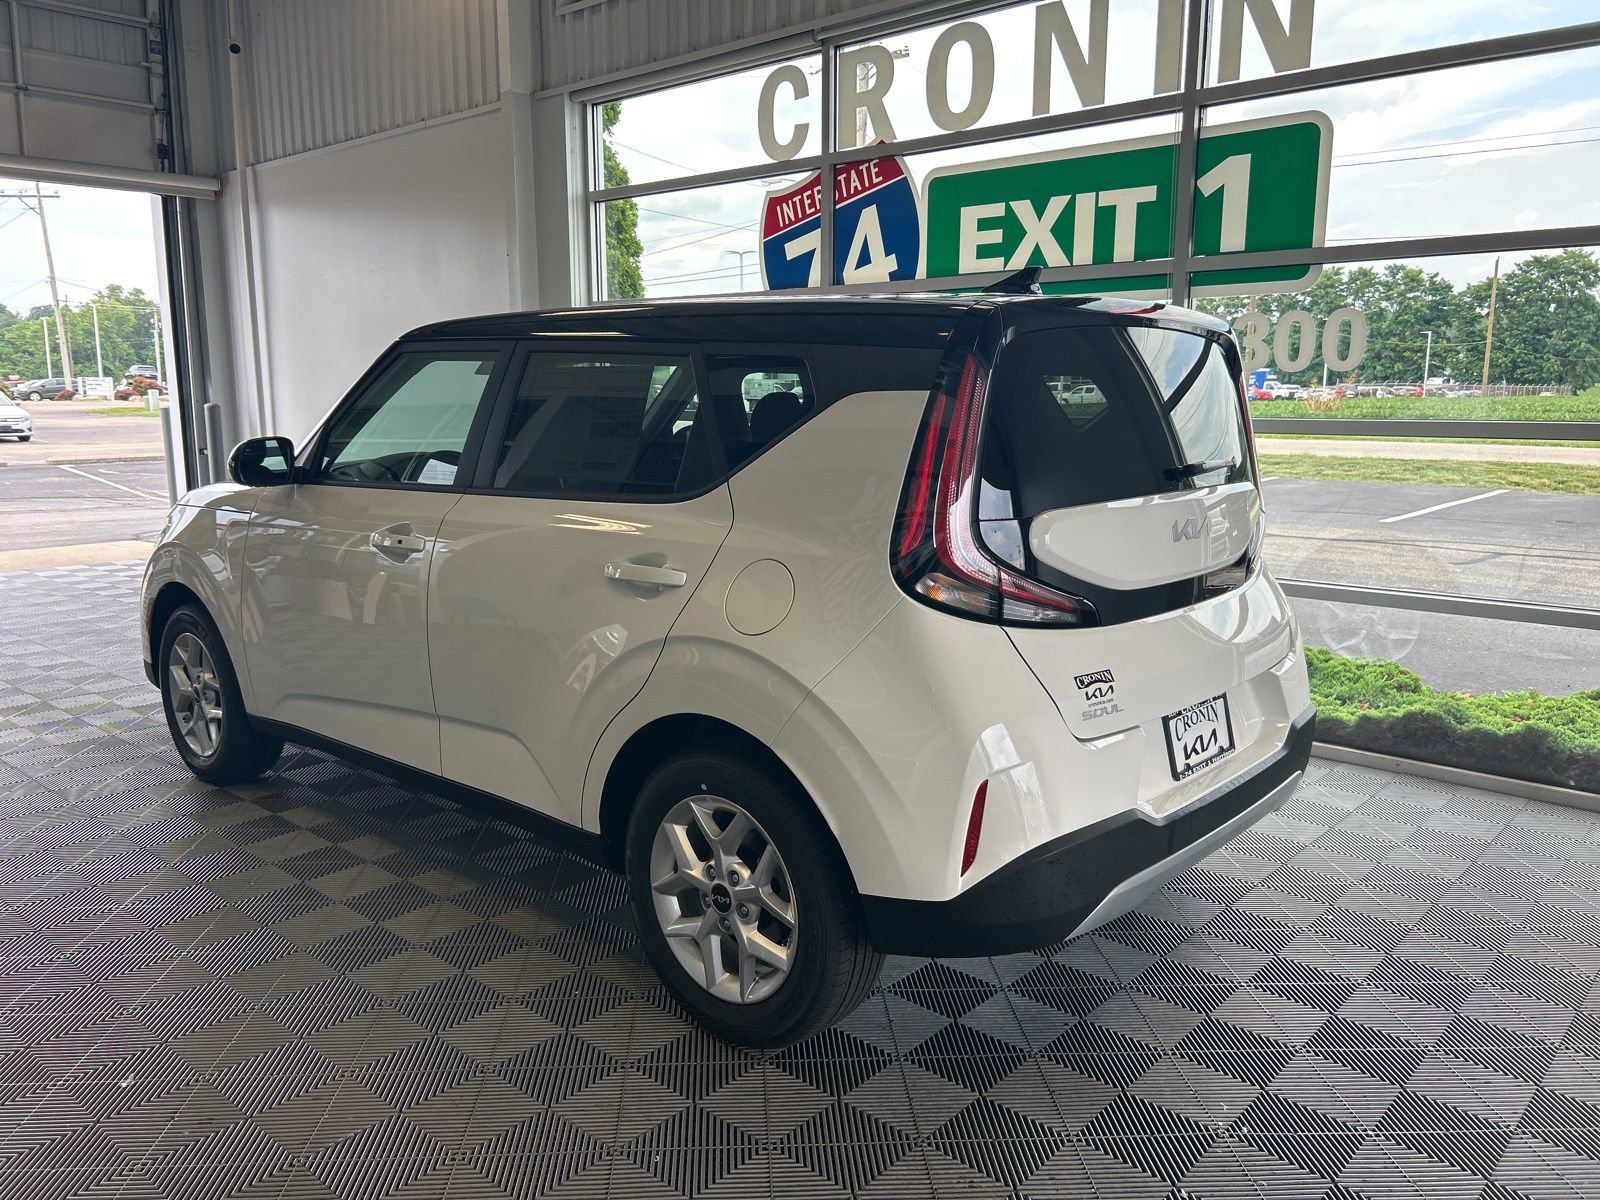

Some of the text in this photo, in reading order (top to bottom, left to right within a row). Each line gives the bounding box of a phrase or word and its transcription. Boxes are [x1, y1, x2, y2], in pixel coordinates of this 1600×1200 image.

[758, 0, 1315, 162] CRONIN
[958, 153, 1252, 274] EXIT 1
[784, 203, 898, 288] 74
[1171, 514, 1209, 543] KIA
[1076, 670, 1113, 689] CRONIN
[1085, 685, 1114, 701] KIA
[1081, 704, 1125, 721] SOUL
[1175, 702, 1219, 742] CRONIN
[1183, 728, 1218, 761] KIA
